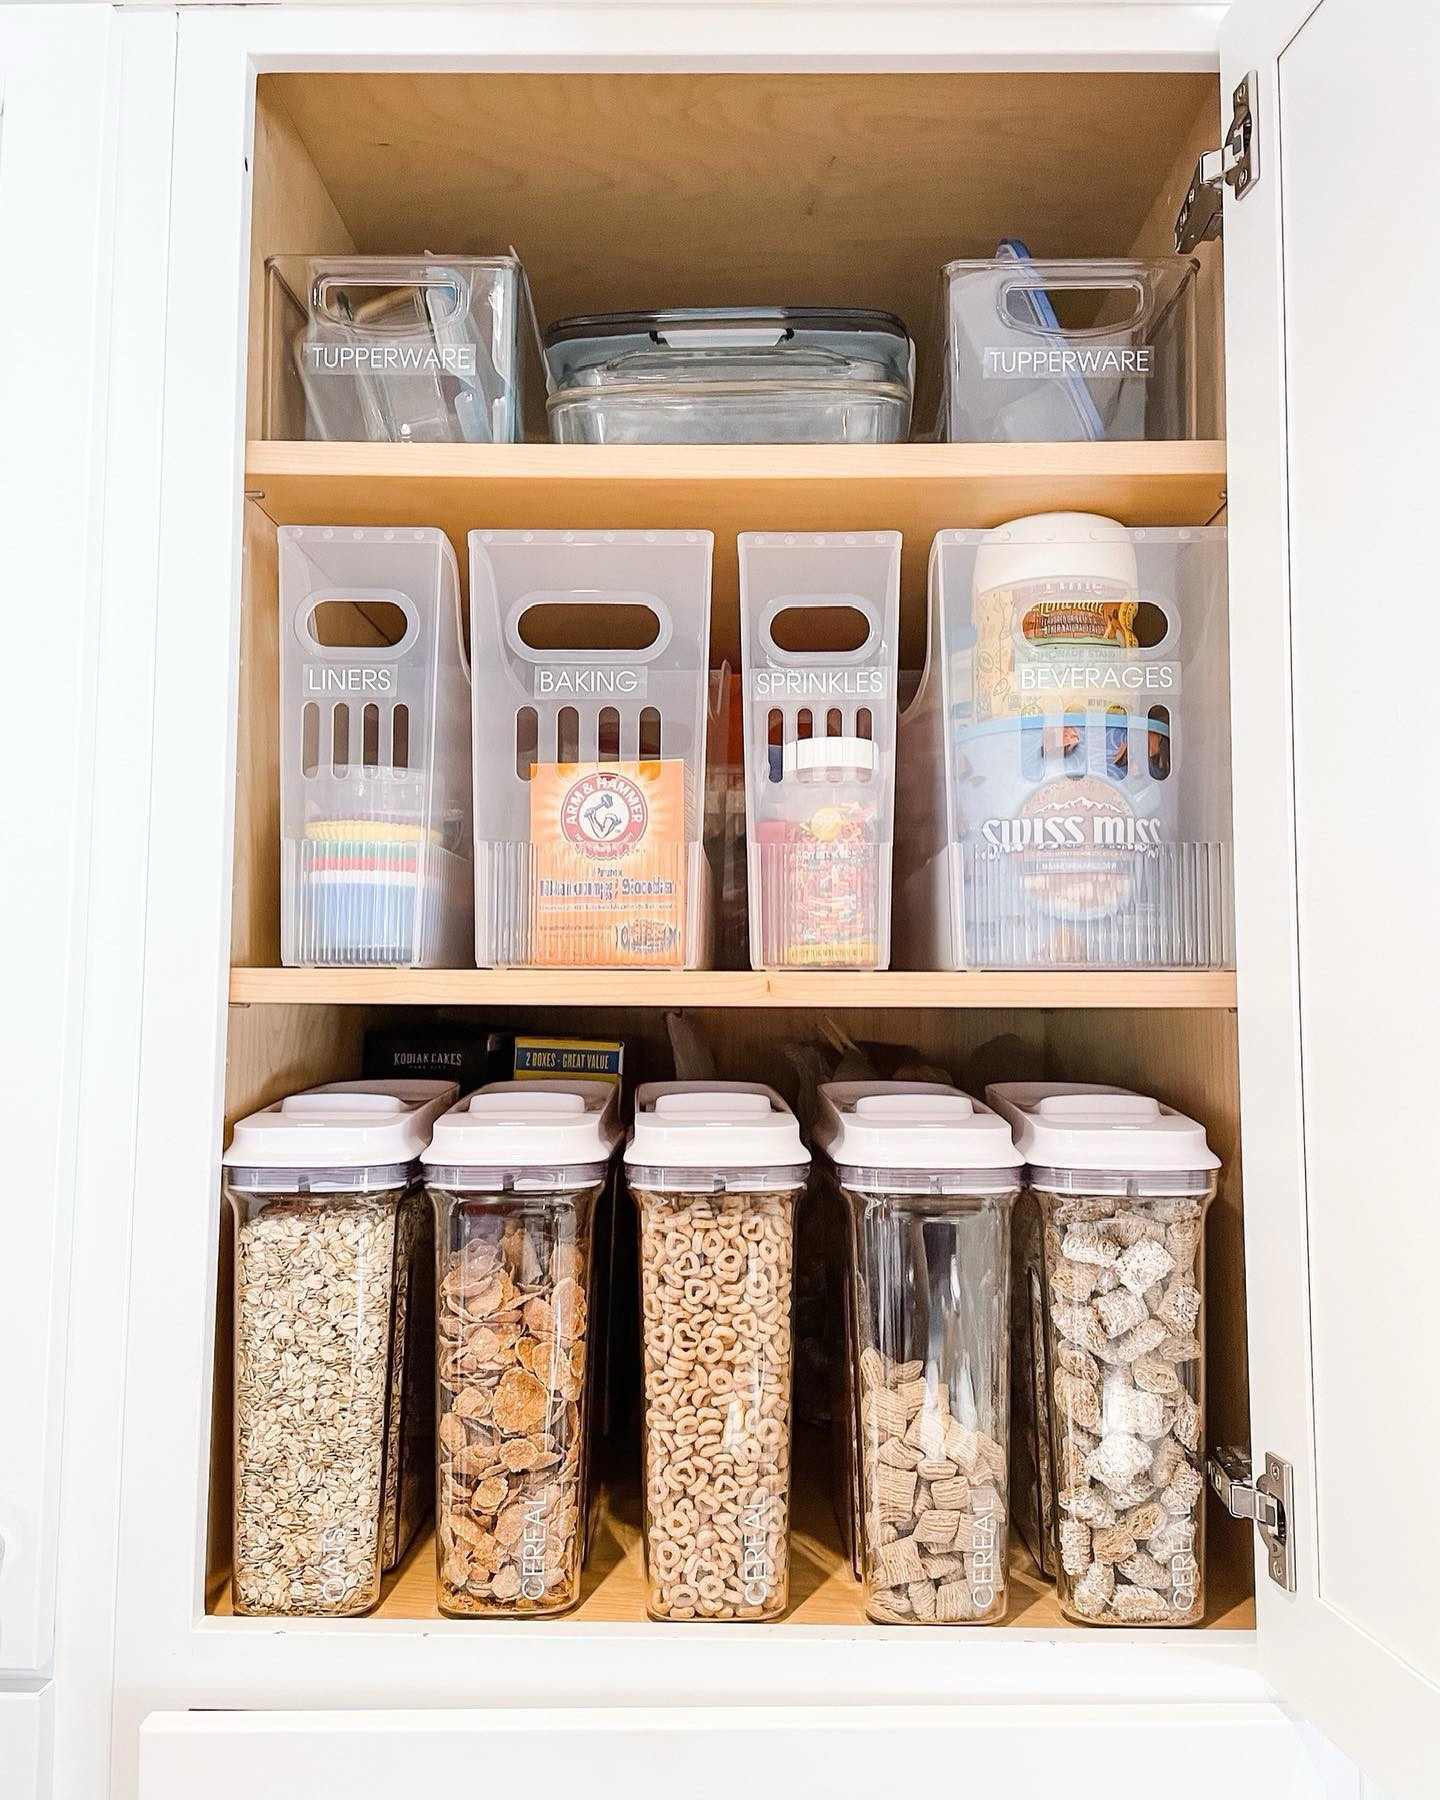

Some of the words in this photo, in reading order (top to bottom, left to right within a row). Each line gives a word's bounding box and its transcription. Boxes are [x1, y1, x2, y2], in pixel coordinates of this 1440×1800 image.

[311, 346, 471, 371] TUPPERWARE
[989, 350, 1150, 373] TUPPERWARE
[308, 669, 391, 691] LINERS
[539, 670, 639, 693] BAKING
[756, 671, 883, 695] SPRINKLES
[1021, 666, 1173, 690] BEVERAGES
[565, 790, 583, 825] ARM
[582, 782, 593, 794] &
[596, 777, 644, 824] HAMMER
[393, 1052, 429, 1066] KODIAK
[431, 1052, 462, 1066] CAKES
[525, 1052, 531, 1067] 2
[532, 1052, 557, 1067] BOXES
[562, 1053, 586, 1069] GREAT
[586, 1054, 610, 1070] VALUE
[521, 1491, 547, 1600] CEREAL
[744, 1495, 768, 1606] CEREAL
[972, 1497, 995, 1609] CEREAL
[1170, 1503, 1195, 1611] CEREAL
[322, 1528, 347, 1602] OATS
